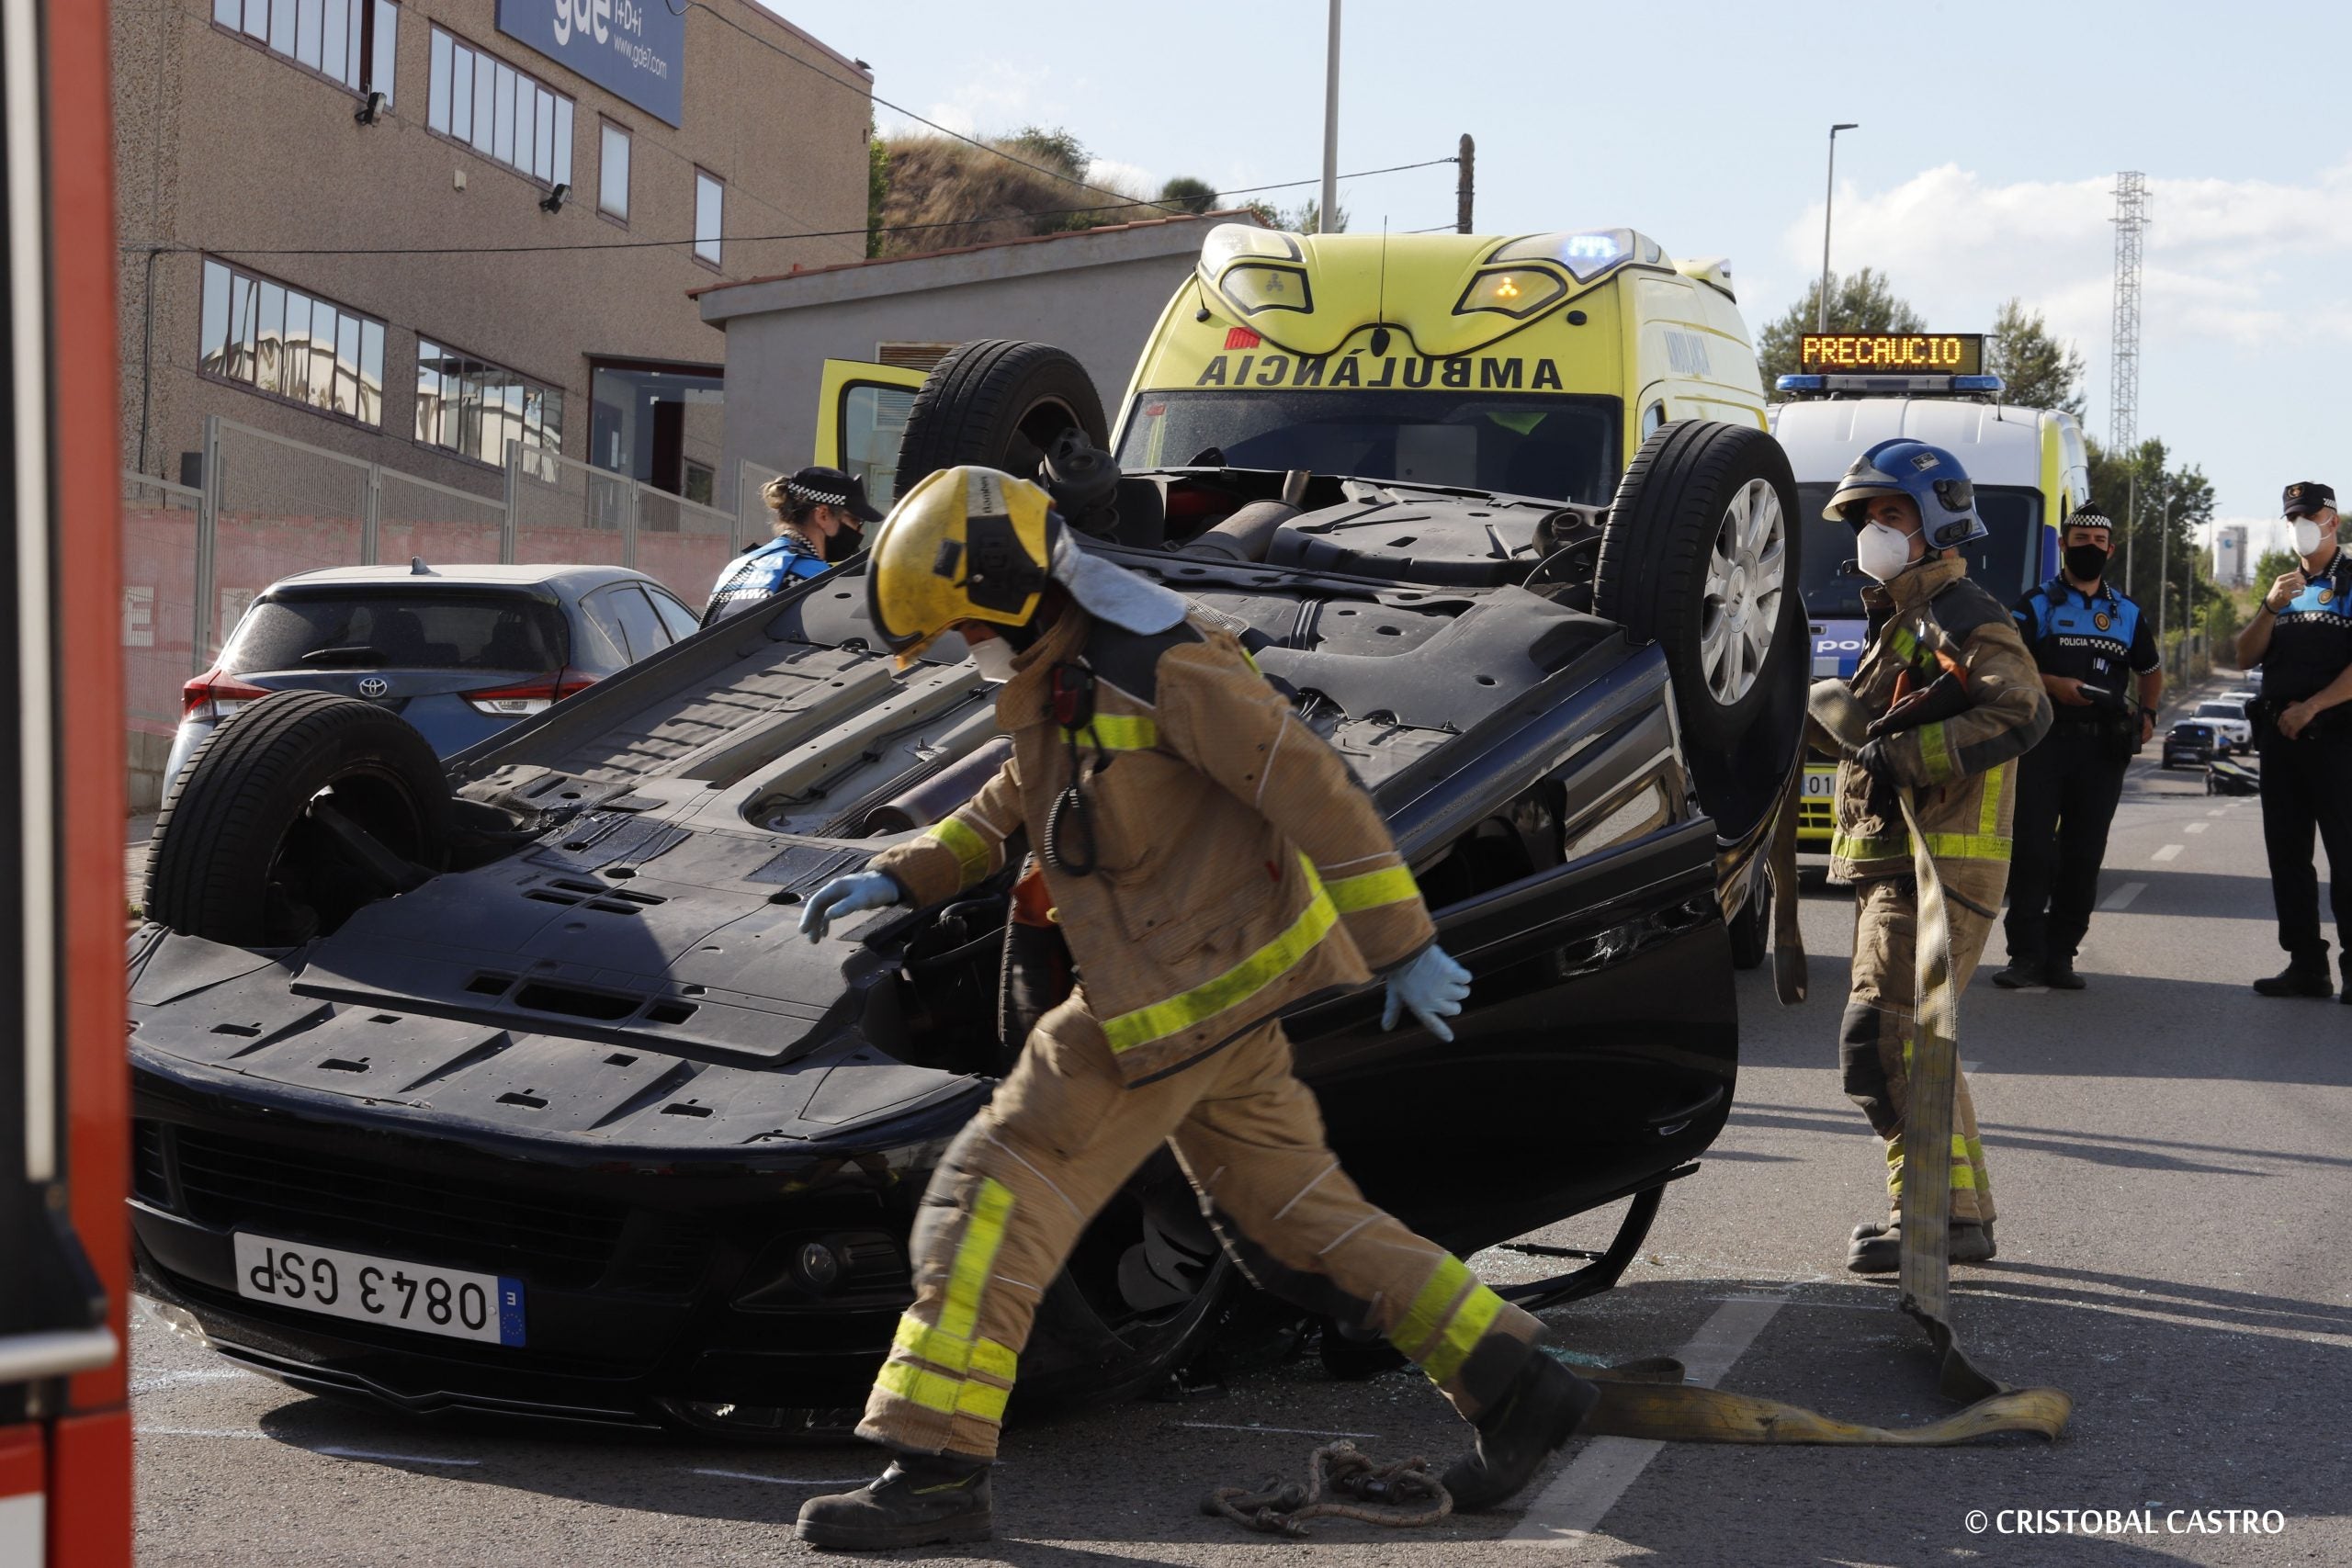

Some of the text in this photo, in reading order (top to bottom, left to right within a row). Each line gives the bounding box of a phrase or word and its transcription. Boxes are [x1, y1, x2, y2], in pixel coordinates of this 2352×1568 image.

[1804, 337, 1961, 364] PRECAUCIO
[2059, 637, 2088, 647] POLICIA
[250, 1247, 487, 1331] 0843 GSP
